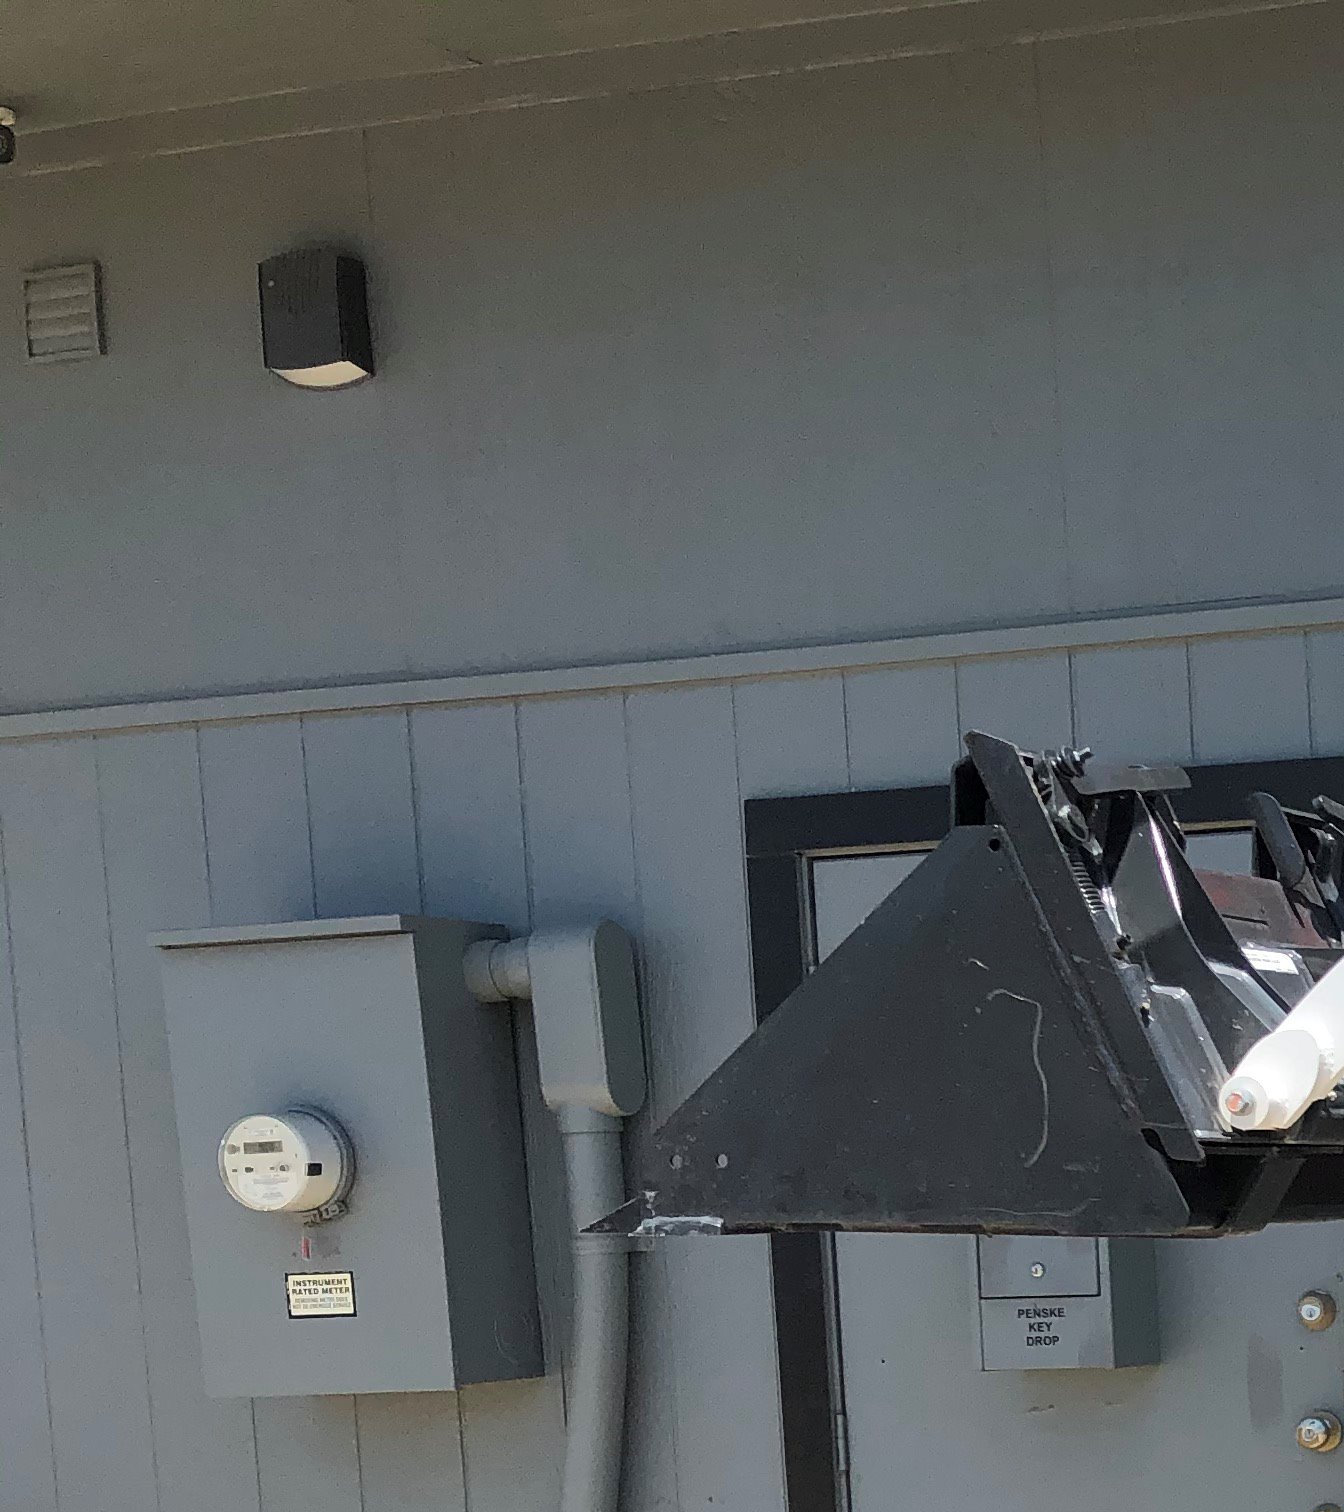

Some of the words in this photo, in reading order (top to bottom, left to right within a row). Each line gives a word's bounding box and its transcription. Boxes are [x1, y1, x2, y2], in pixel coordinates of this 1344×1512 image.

[292, 1278, 348, 1287] INSTRUMENT
[321, 1286, 350, 1294] METER
[1017, 1307, 1066, 1319] PENSKE
[1028, 1322, 1053, 1333] KEY
[1026, 1335, 1060, 1347] DROP
